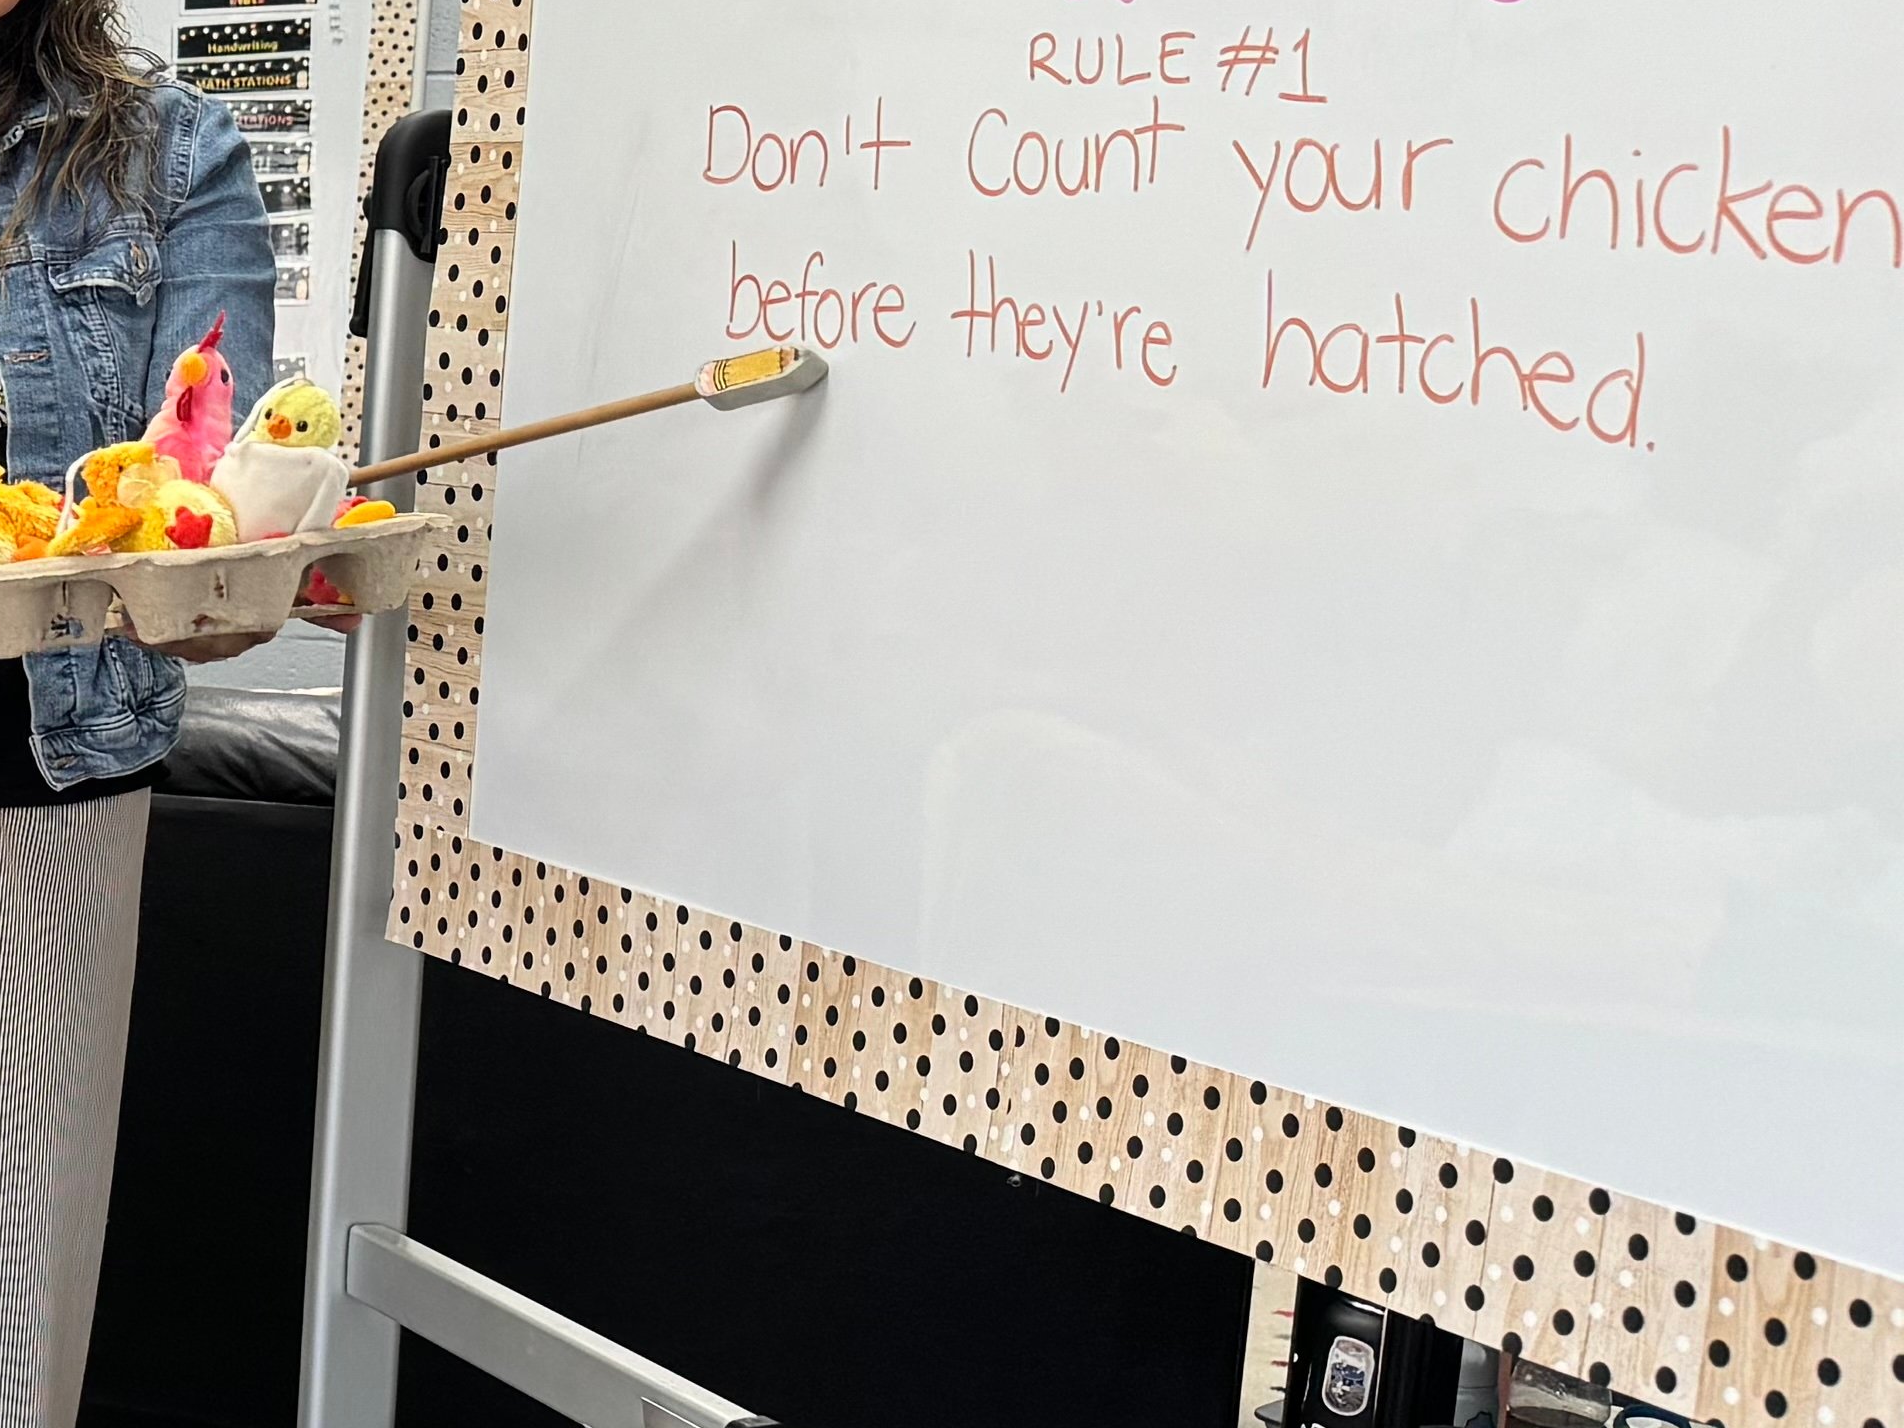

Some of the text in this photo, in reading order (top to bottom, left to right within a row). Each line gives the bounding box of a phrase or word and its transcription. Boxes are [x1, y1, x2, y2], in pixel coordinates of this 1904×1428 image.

[207, 39, 279, 54] Handwriting
[233, 74, 292, 88] STATIONS
[1029, 25, 1329, 104] RULE #1
[702, 97, 912, 193] Don't
[967, 94, 1186, 198] Count
[1231, 137, 1454, 253] your
[725, 239, 1658, 452] before they're hatched.
